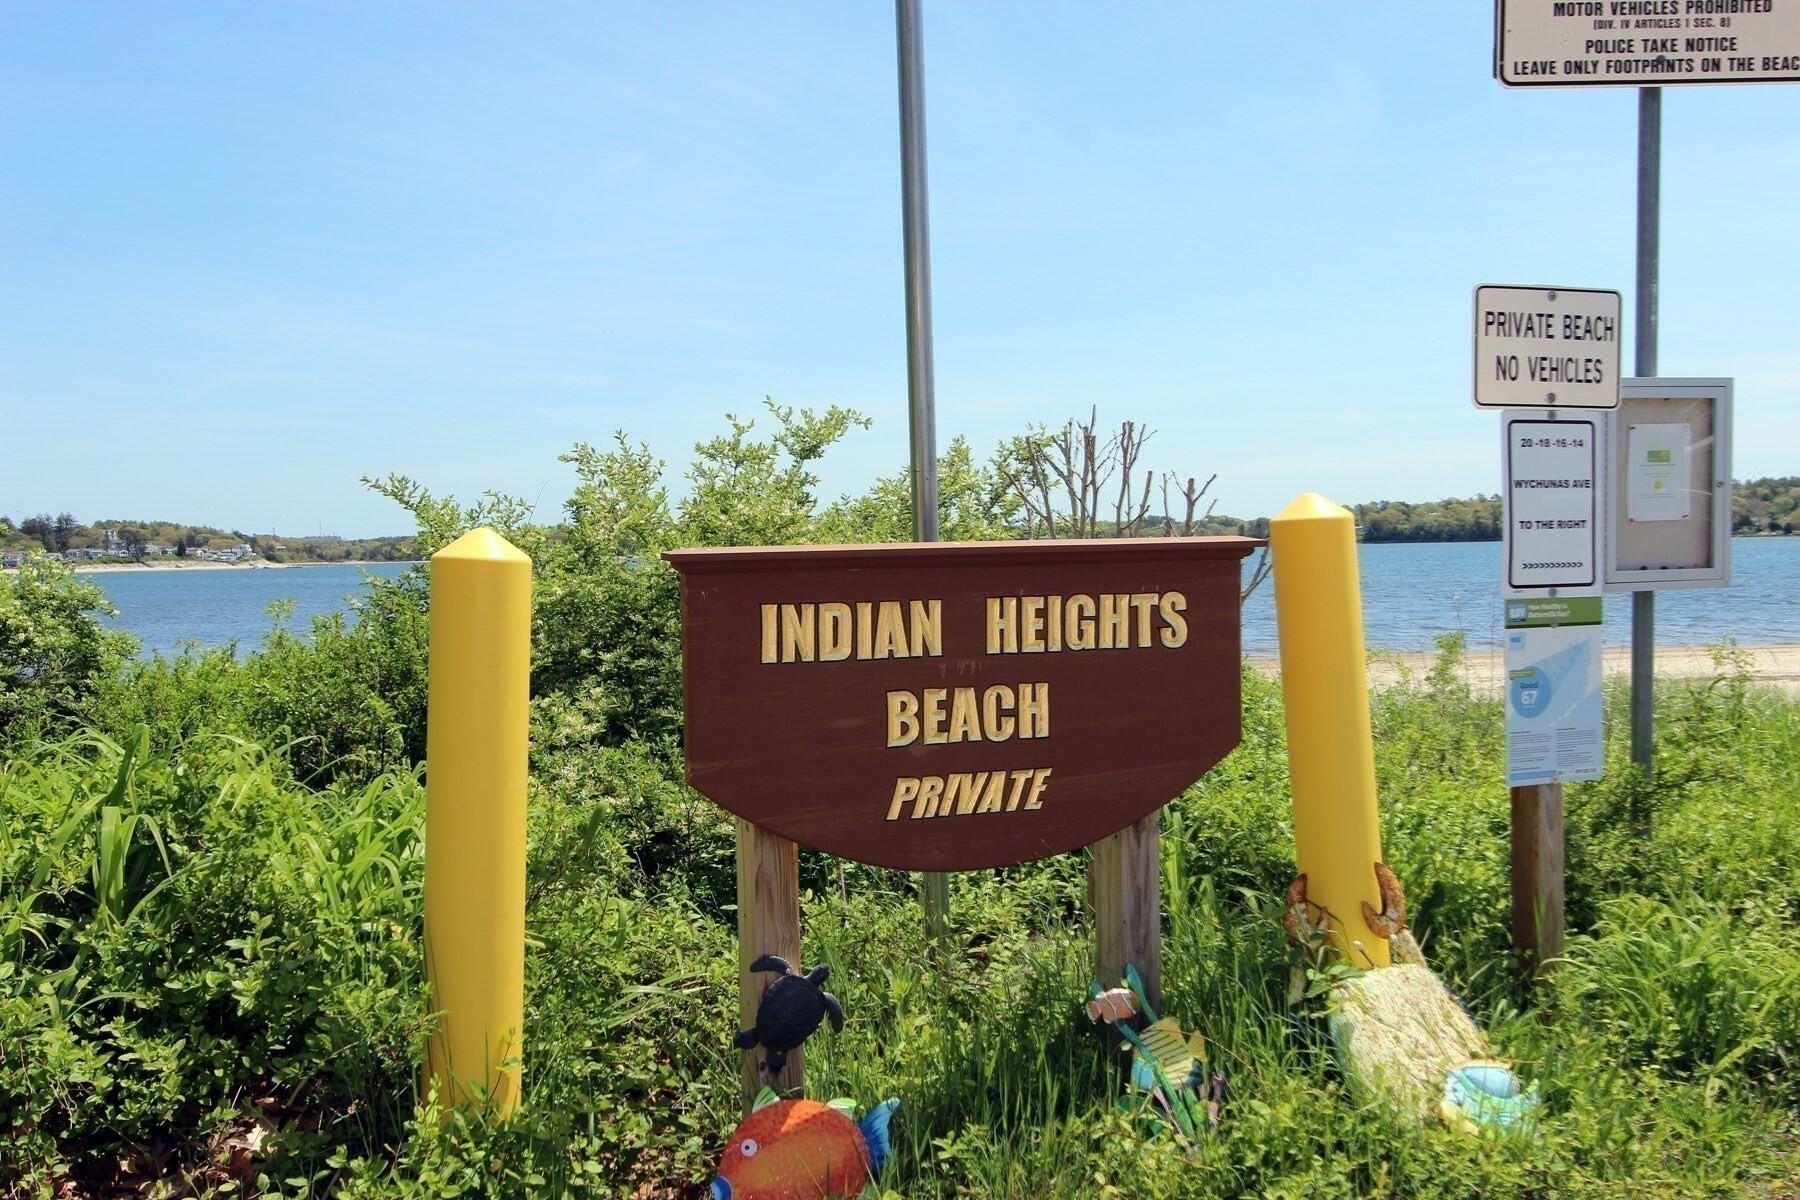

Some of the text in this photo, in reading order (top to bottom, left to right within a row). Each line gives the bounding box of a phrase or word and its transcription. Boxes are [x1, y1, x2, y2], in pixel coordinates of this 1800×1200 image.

[1553, 0, 1772, 17] MOTOR VEHICLES PROHIBITED
[1620, 20, 1630, 29] IV
[1634, 18, 1680, 29] ARTICLES
[1693, 17, 1716, 28] SEC.
[1585, 37, 1737, 54] POLICE TAKE NOTICE
[1513, 60, 1557, 76] LEAVE
[1563, 59, 1599, 75] ONLY
[1605, 58, 1694, 75] FOOTPRINTS
[1701, 58, 1721, 73] ON
[1728, 57, 1755, 72] THE
[1484, 311, 1615, 342] PRIVATE BEACH
[1496, 355, 1603, 384] NO VEHICLES
[1513, 479, 1592, 489] WYCHUNAS AVE
[1518, 519, 1587, 530] TO THE RIGHT
[760, 591, 1188, 664] INDIAN HEIGHTS
[886, 682, 1050, 748] BEACH
[885, 767, 1053, 821] PRIVATE
